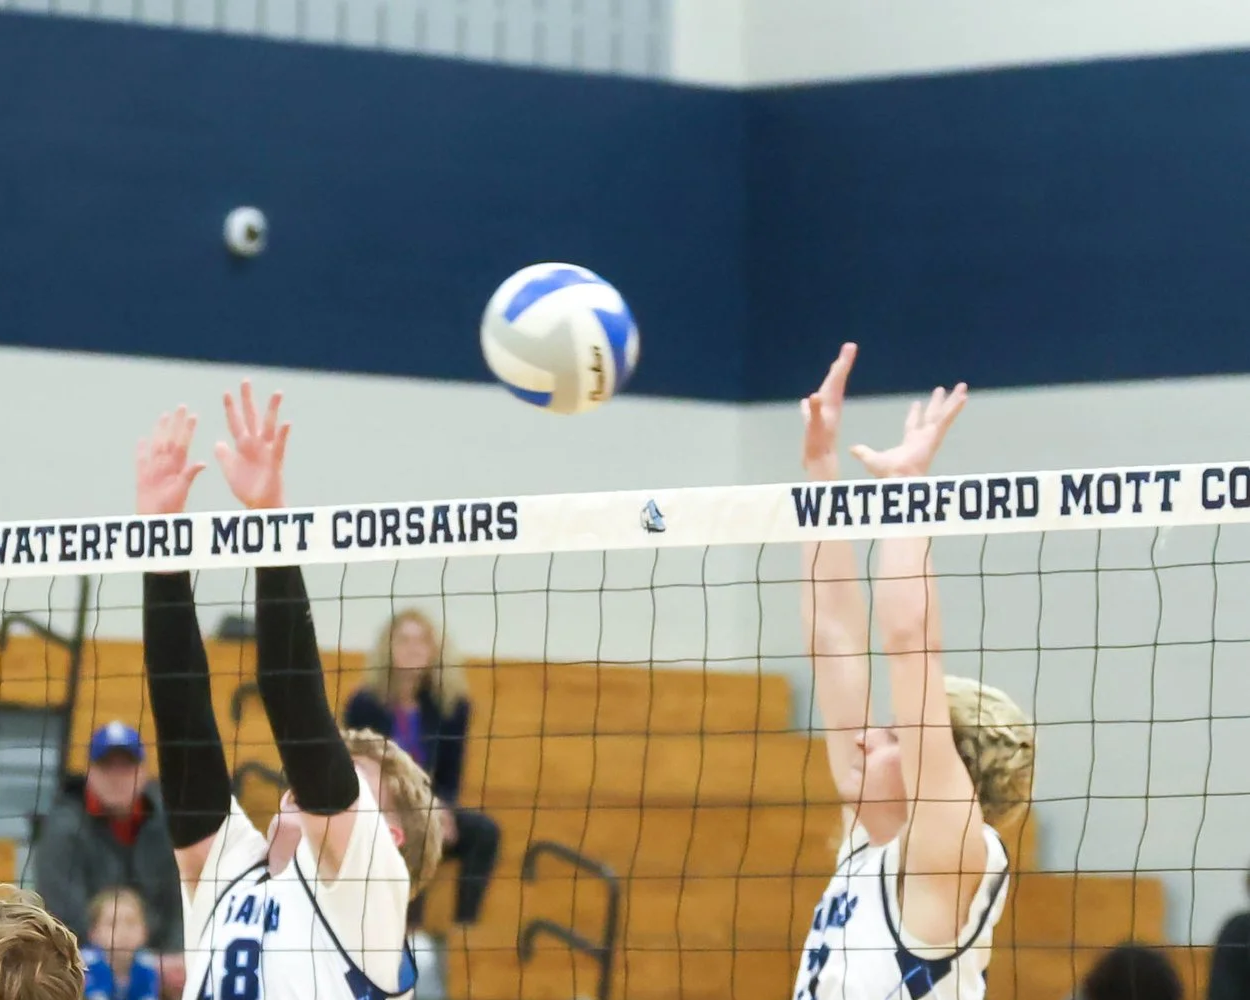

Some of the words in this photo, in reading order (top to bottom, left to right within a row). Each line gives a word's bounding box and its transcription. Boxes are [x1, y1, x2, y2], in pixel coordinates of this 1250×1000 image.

[791, 476, 1040, 527] WATERFORD
[1060, 470, 1181, 516] MOTT
[1201, 466, 1250, 510] CO
[211, 512, 314, 555] MOTT
[332, 501, 519, 549] CORSAIRS
